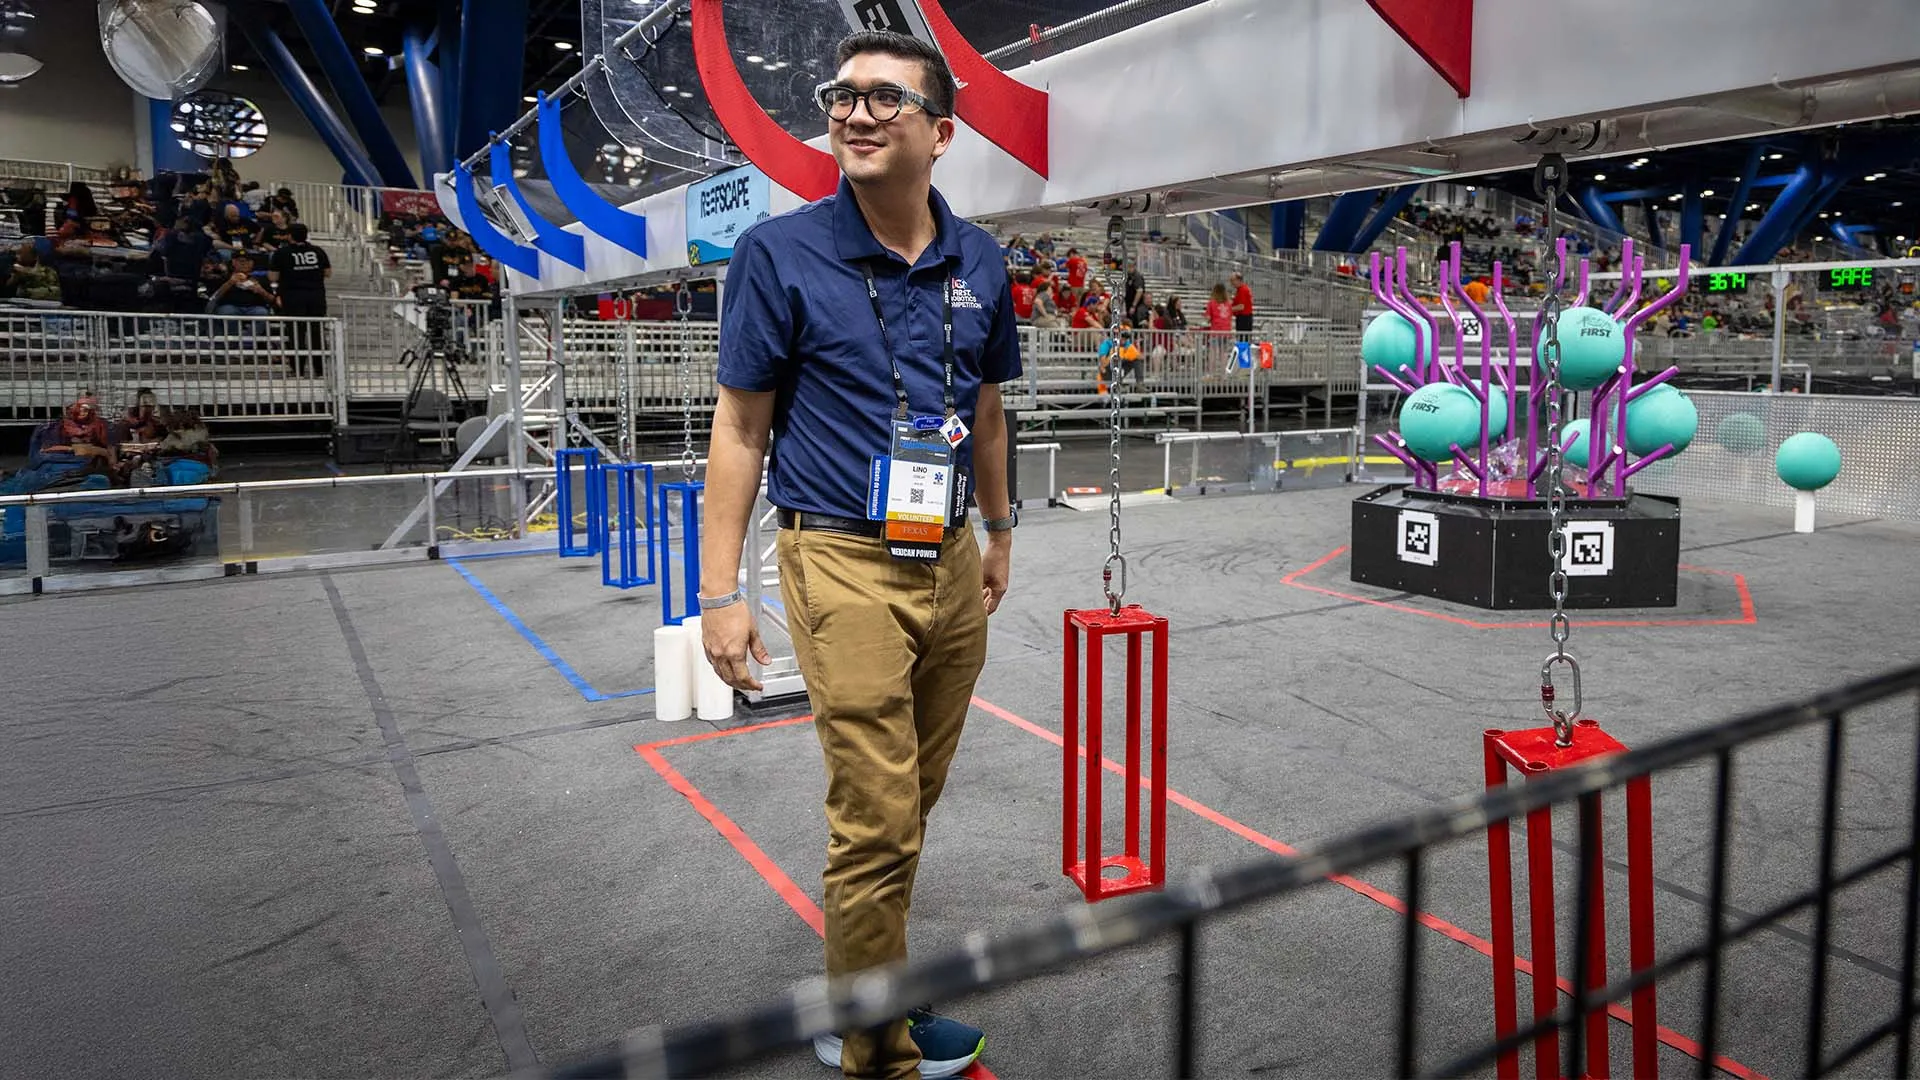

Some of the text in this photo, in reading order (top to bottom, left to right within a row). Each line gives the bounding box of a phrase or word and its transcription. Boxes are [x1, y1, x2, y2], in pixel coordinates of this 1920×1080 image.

[700, 176, 749, 218] REEFSCAPE
[291, 251, 319, 265] 118
[1709, 272, 1746, 291] 3674
[1831, 267, 1873, 287] SAFE
[1580, 328, 1611, 338] FIRST
[1411, 402, 1440, 414] FIRST
[897, 512, 935, 523] VOLUNTEER
[903, 526, 929, 536] TEXAS
[916, 549, 937, 559] POWER
